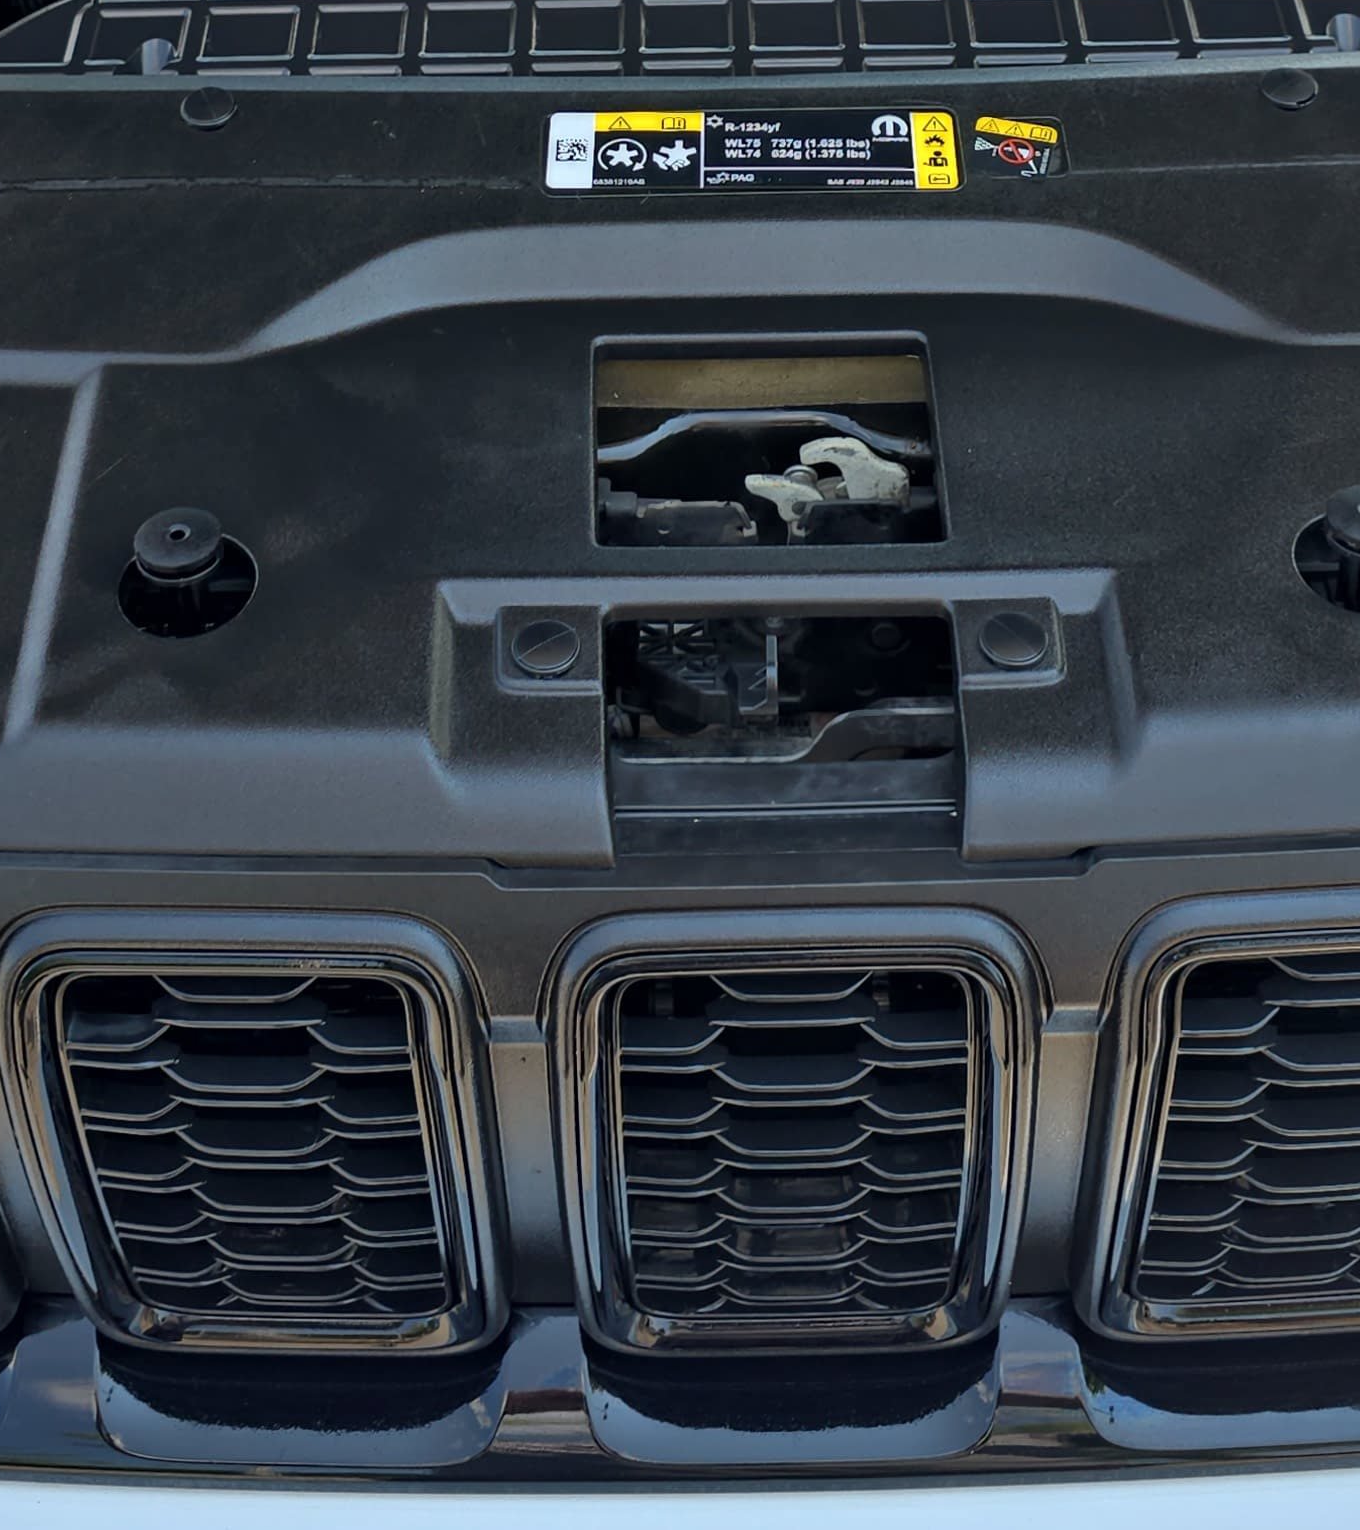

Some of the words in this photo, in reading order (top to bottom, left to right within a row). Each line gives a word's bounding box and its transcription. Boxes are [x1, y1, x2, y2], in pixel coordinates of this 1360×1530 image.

[724, 122, 781, 134] R-1234yf
[724, 138, 762, 149] WL75
[770, 138, 802, 150] 737g
[805, 138, 843, 150] (1.625
[846, 138, 871, 150] lbs)
[724, 149, 762, 159] WL74
[770, 149, 802, 160] 624g
[805, 149, 844, 160] (1.375
[846, 149, 872, 160] lbs)
[730, 173, 755, 183] PAG
